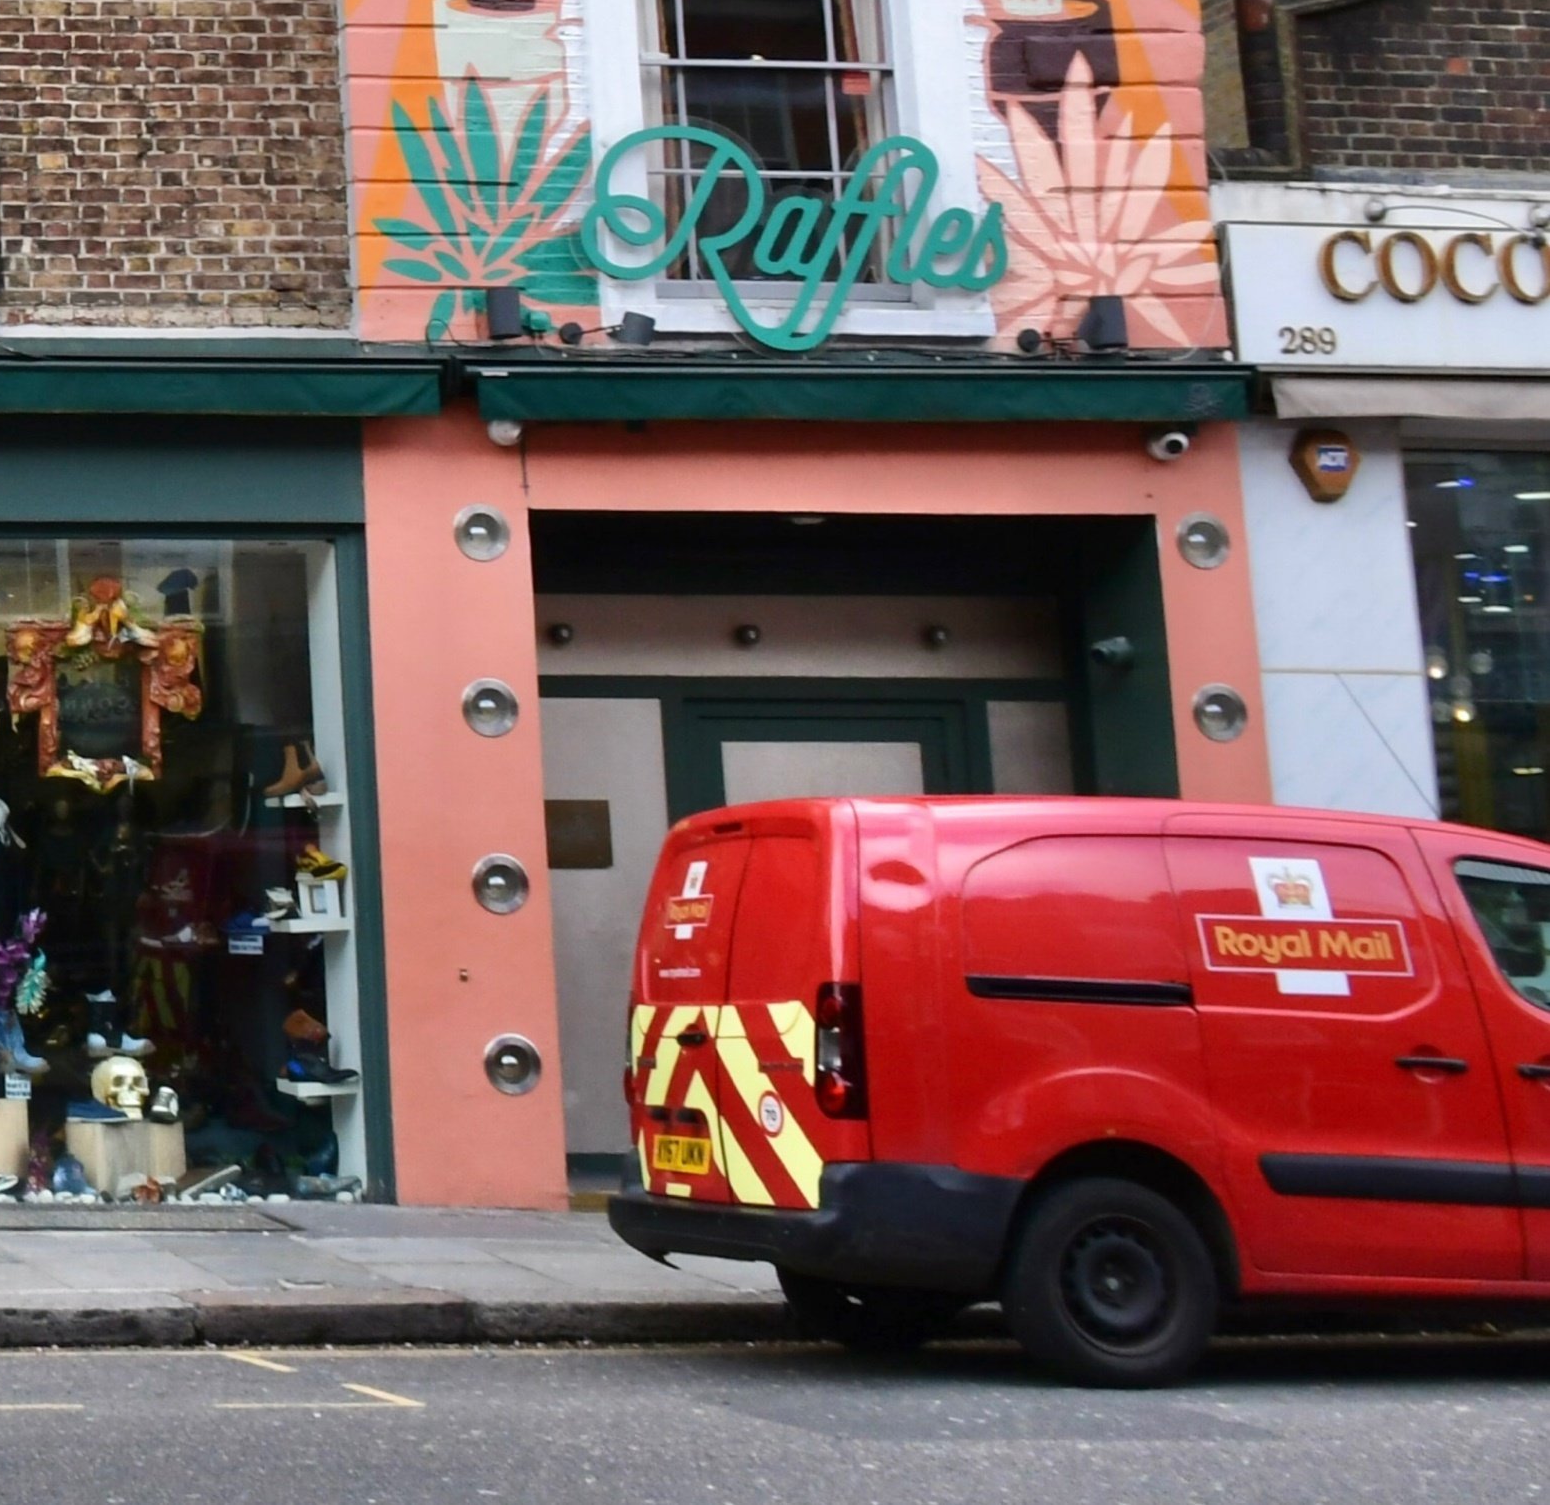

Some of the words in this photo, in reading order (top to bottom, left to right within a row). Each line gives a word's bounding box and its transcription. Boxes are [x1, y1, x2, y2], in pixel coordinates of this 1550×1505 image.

[579, 124, 1009, 352] Raffles
[1278, 326, 1338, 355] 289
[1213, 926, 1312, 964] Royal
[1319, 930, 1395, 961] Mail
[764, 1107, 777, 1122] 70
